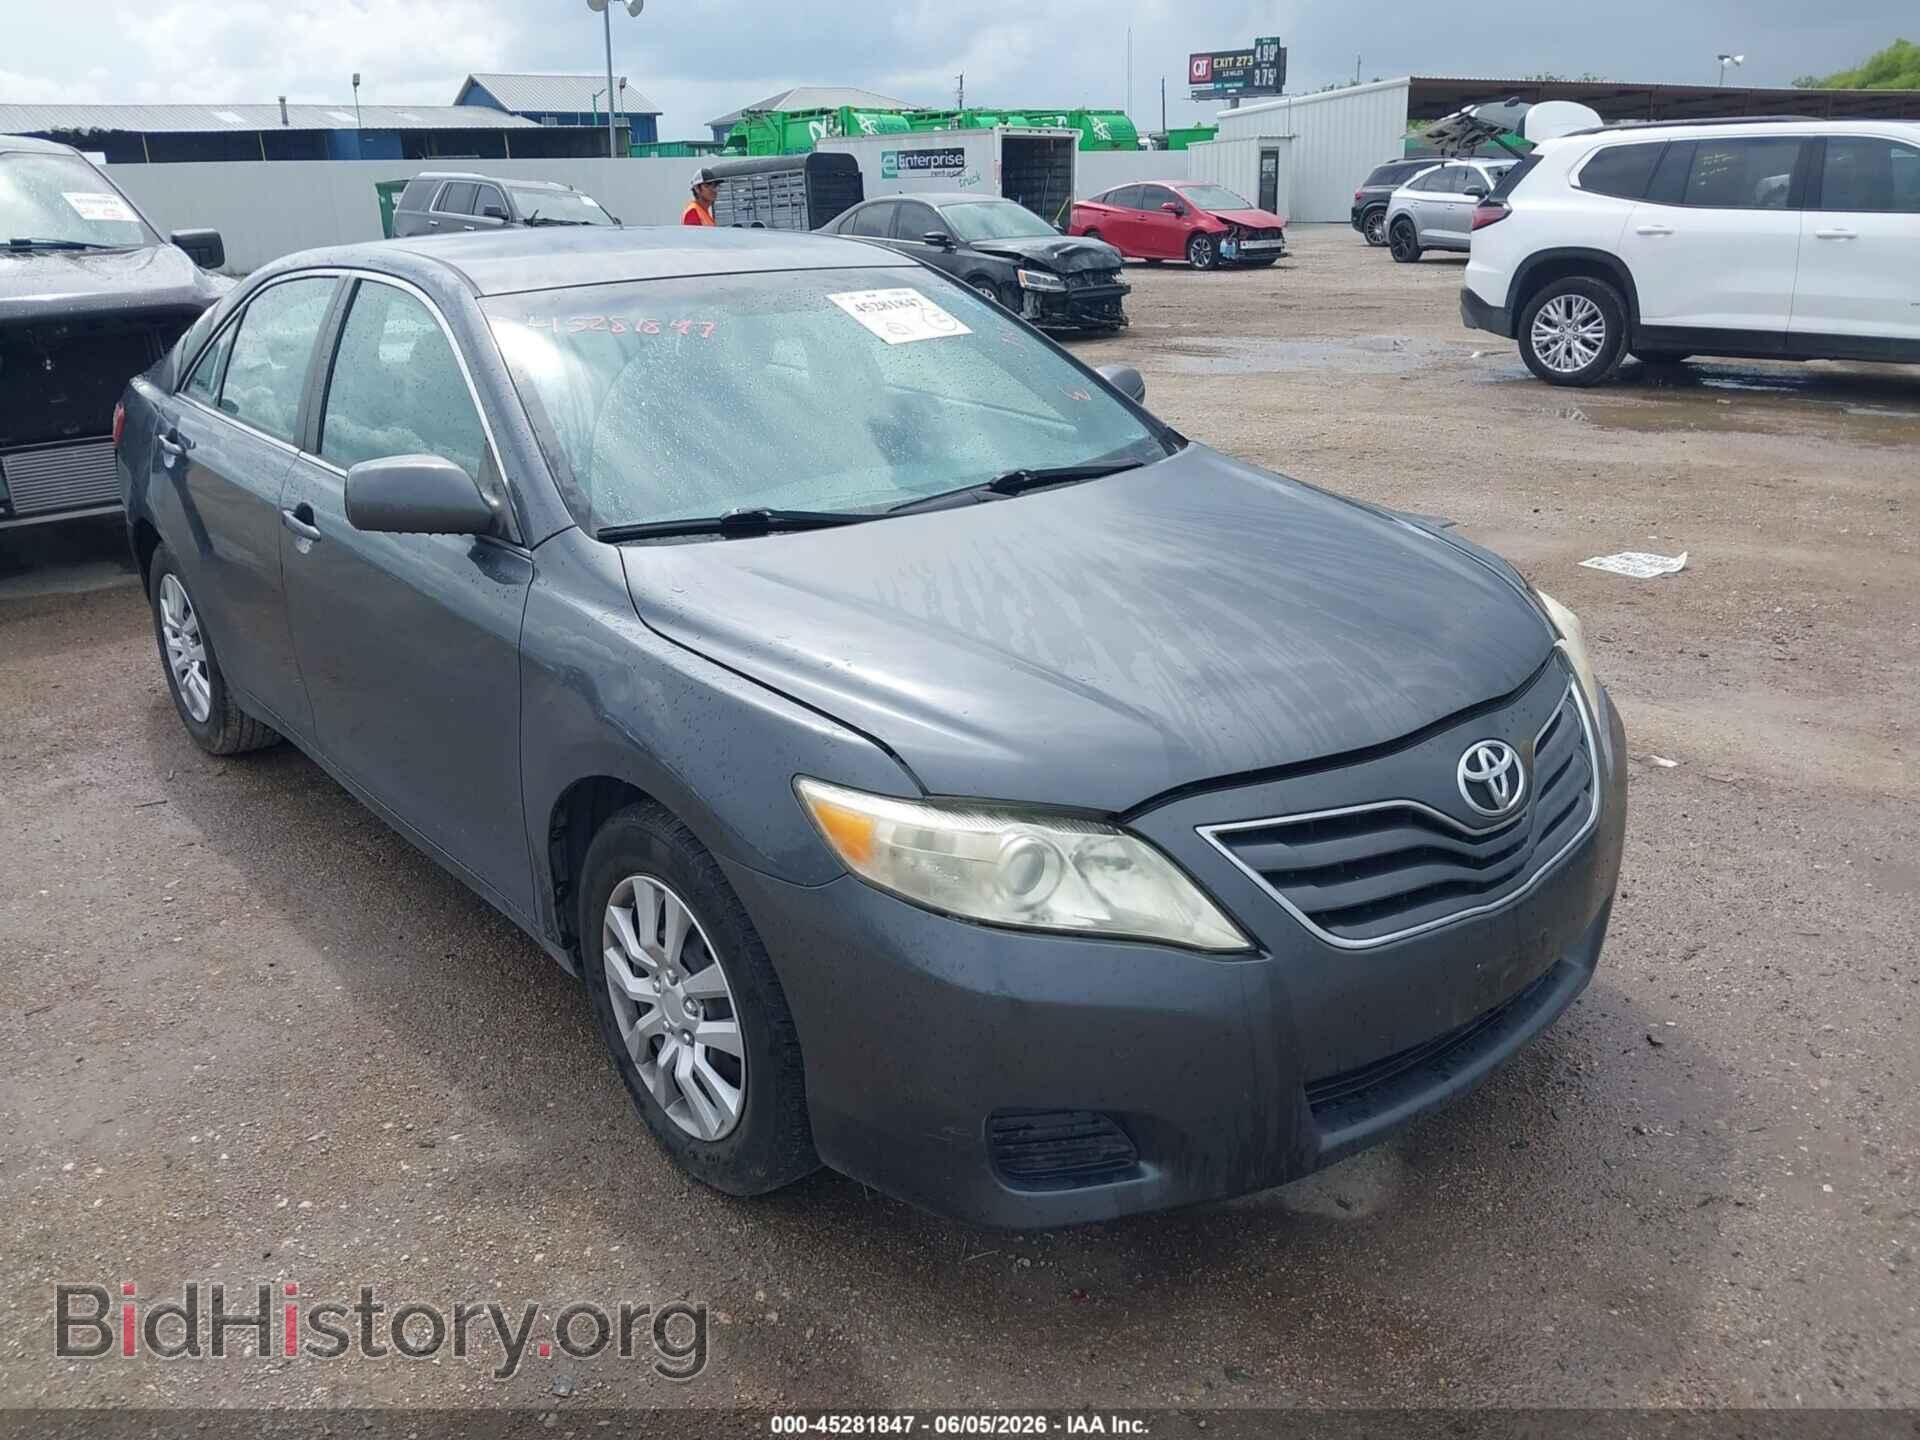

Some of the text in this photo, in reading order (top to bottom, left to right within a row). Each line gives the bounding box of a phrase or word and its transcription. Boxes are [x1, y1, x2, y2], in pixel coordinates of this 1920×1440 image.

[1193, 60, 1209, 77] QT
[1213, 55, 1254, 69] EXIT 273
[898, 150, 964, 170] Enterprise
